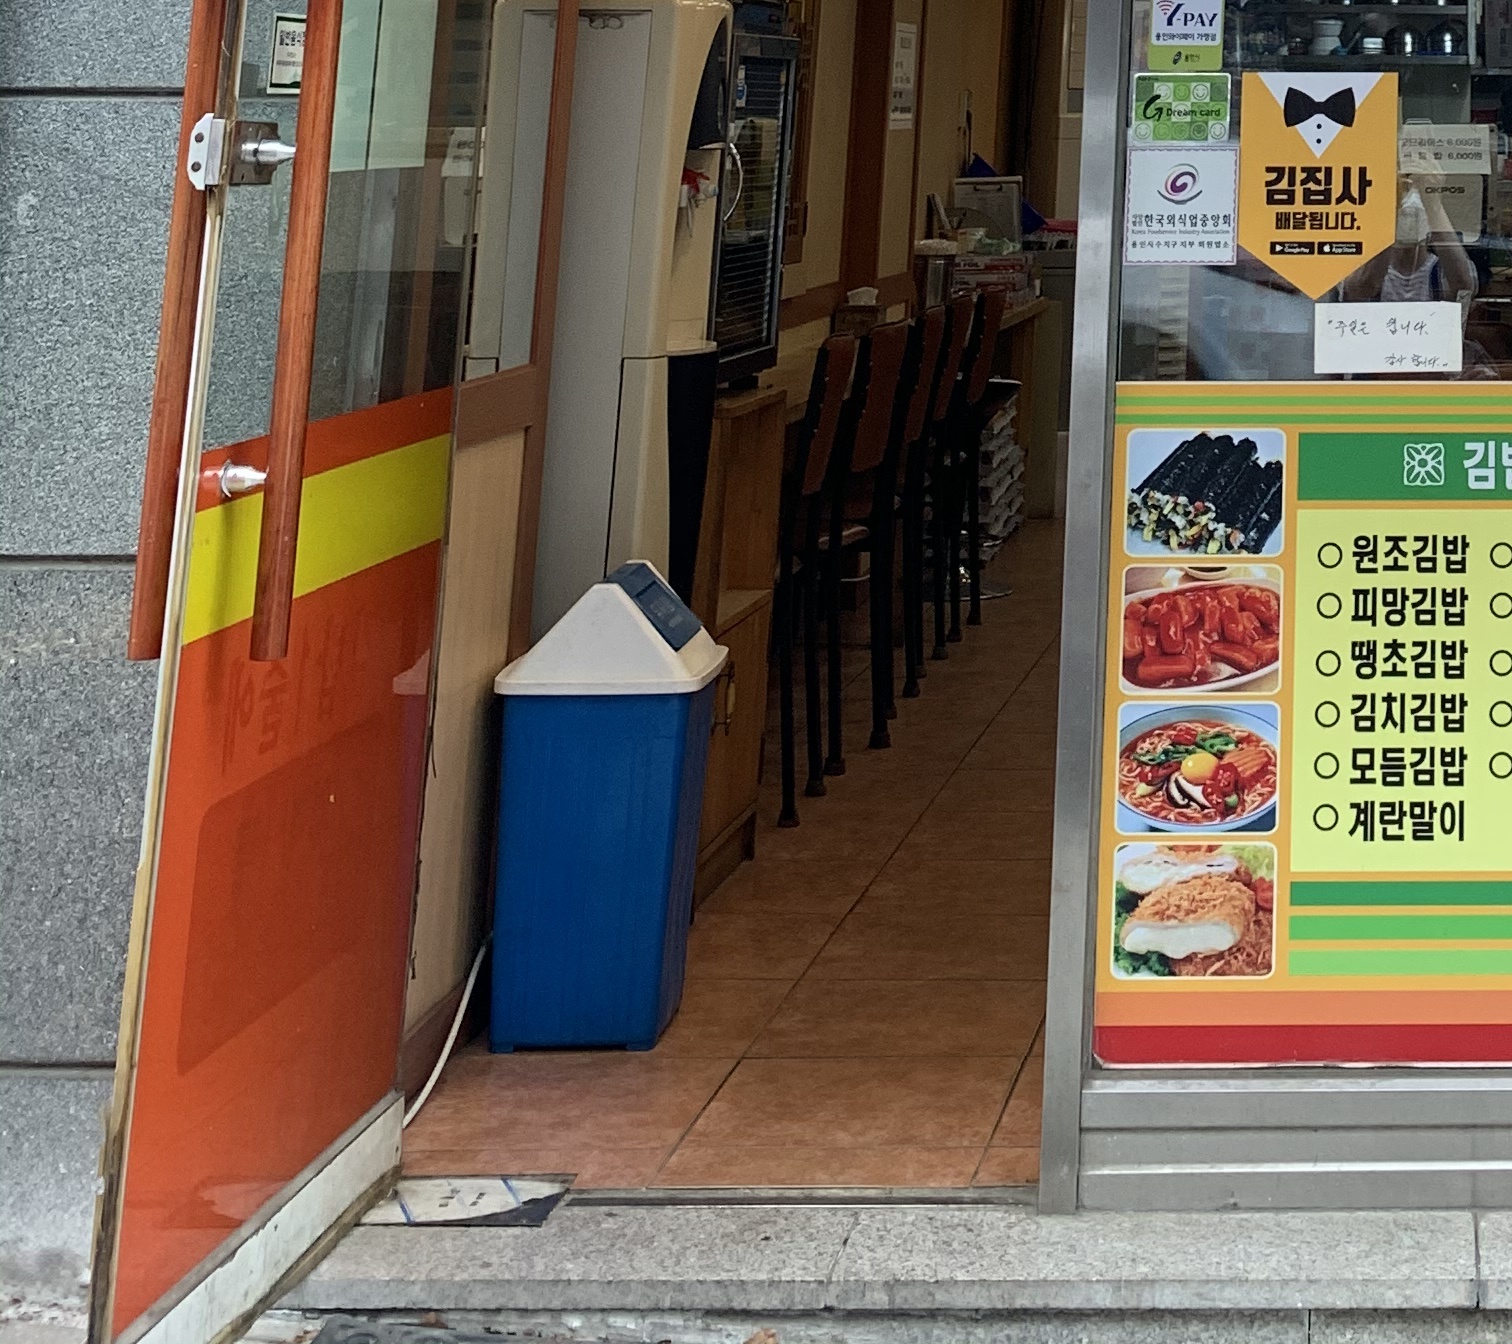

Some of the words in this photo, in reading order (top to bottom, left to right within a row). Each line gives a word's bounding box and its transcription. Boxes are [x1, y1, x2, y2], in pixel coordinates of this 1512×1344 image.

[1166, 108, 1197, 117] Dream
[1265, 166, 1372, 205] 김집사
[1144, 214, 1231, 227] 한국외식업중앙회
[1275, 211, 1361, 230] 배달됩니다.
[1351, 533, 1470, 574] 원조김밥
[1351, 586, 1469, 628] 피망김밥
[1350, 638, 1469, 680] 땡초김밥
[1349, 691, 1468, 734] 김치김밥
[1349, 743, 1468, 787] 모듬김밥
[1348, 799, 1466, 842] 계란말이
